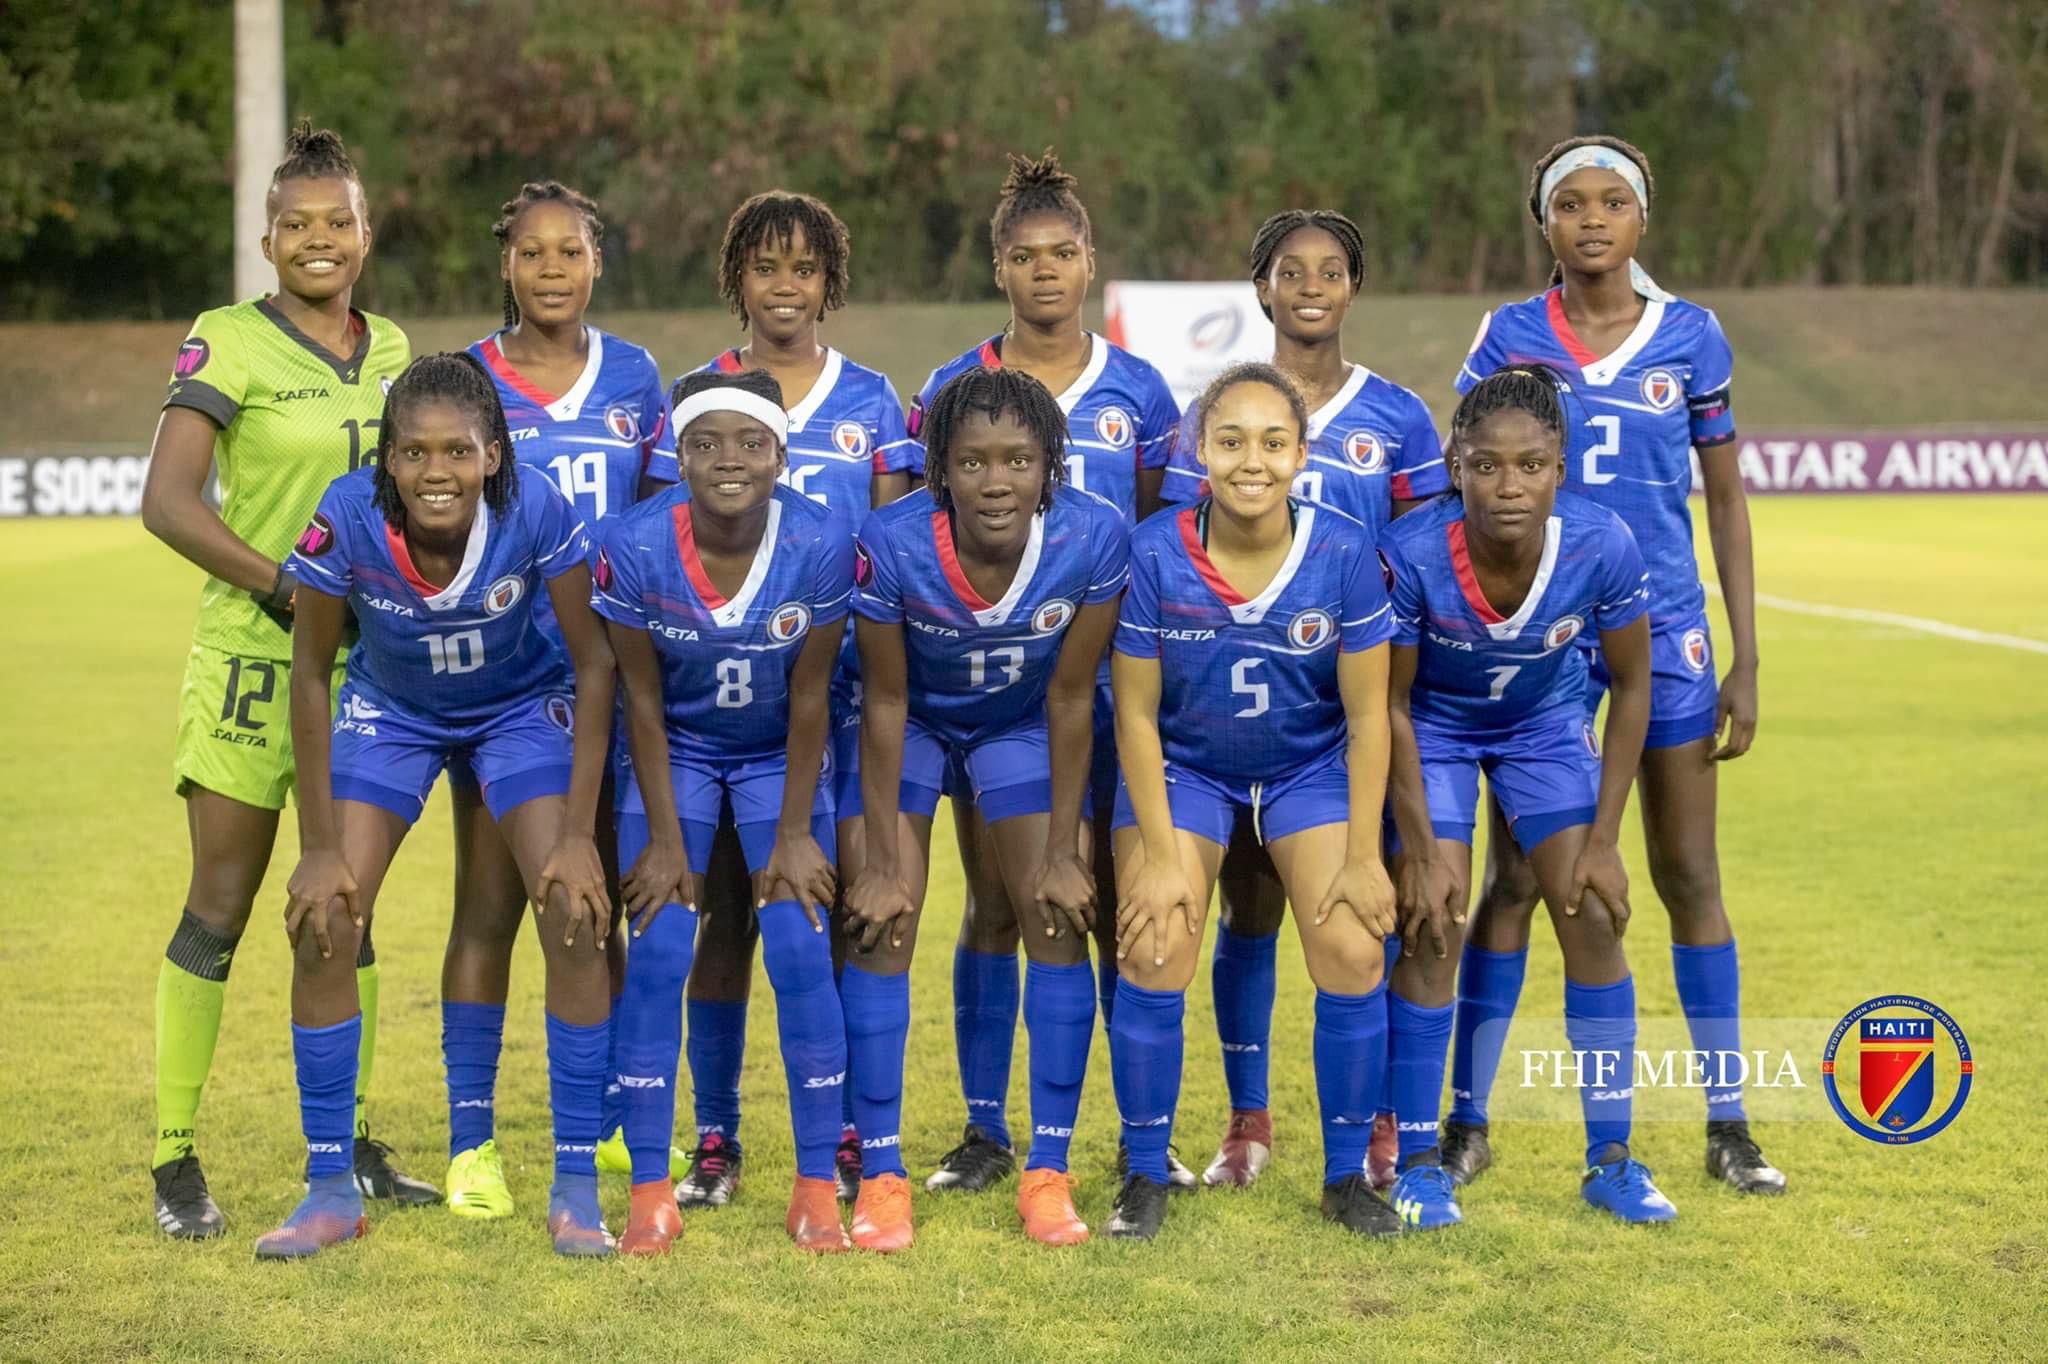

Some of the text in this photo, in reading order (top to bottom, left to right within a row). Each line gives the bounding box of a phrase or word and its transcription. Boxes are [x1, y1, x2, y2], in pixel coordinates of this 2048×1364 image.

[272, 388, 330, 403] SAETA
[510, 427, 540, 442] ETA
[1583, 415, 1620, 484] 2
[32, 456, 152, 515] SOCC
[547, 452, 607, 520] 19
[1877, 440, 2048, 490] AIRWA
[417, 628, 485, 675] 10
[647, 620, 699, 641] SAETA
[1159, 628, 1216, 641] SAETA
[220, 656, 276, 731] 12
[717, 658, 753, 708] 8
[960, 646, 1024, 694] 13
[1231, 657, 1270, 718] 5
[1485, 665, 1521, 701] 7
[210, 728, 267, 748] SAETA
[307, 1143, 342, 1153] ETA
